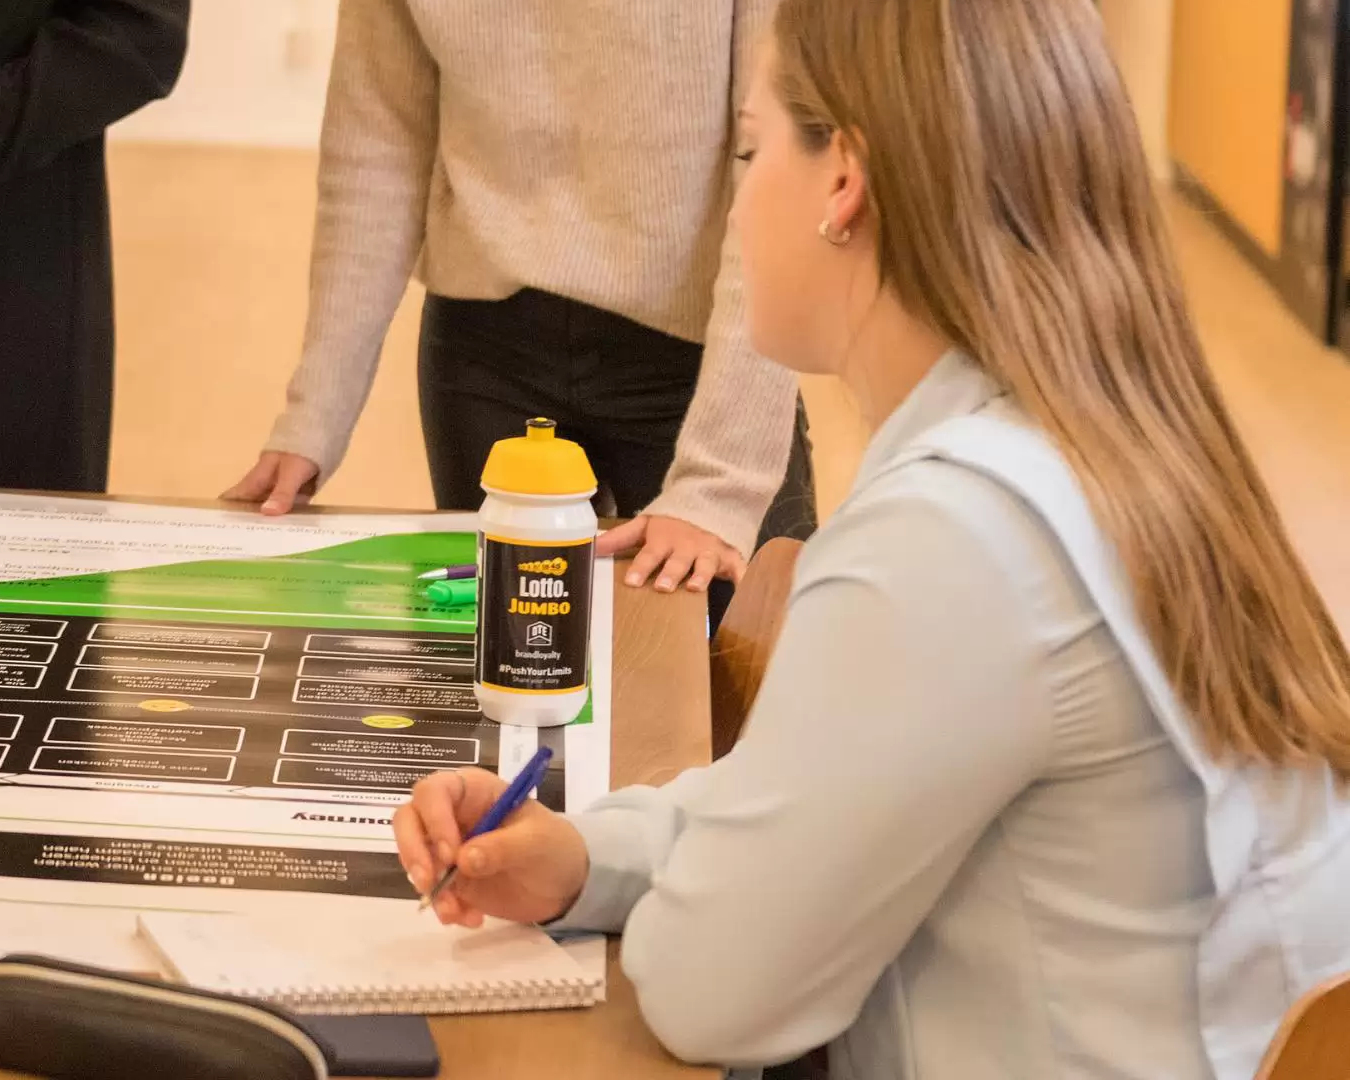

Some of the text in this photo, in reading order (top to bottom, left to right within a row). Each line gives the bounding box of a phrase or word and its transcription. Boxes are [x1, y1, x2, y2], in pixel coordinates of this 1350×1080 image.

[519, 575, 569, 598] Lotto.
[508, 598, 571, 615] JUMBO
[515, 649, 561, 660] brandloyalty
[499, 664, 572, 676] #PushYourLimits
[290, 812, 392, 825] ourney
[43, 845, 89, 854] halen
[111, 841, 152, 849] gaan
[157, 845, 221, 854] uiterste
[42, 852, 132, 863] beheersen
[96, 848, 161, 858] lichaam
[202, 853, 222, 861] uit
[165, 858, 228, 868] kennen
[227, 855, 311, 865] maximale
[316, 859, 346, 867] Het
[34, 859, 347, 881] Conditie opbouwen en fitter worden
[234, 861, 277, 870] leren
[283, 864, 347, 874] Crossfit
